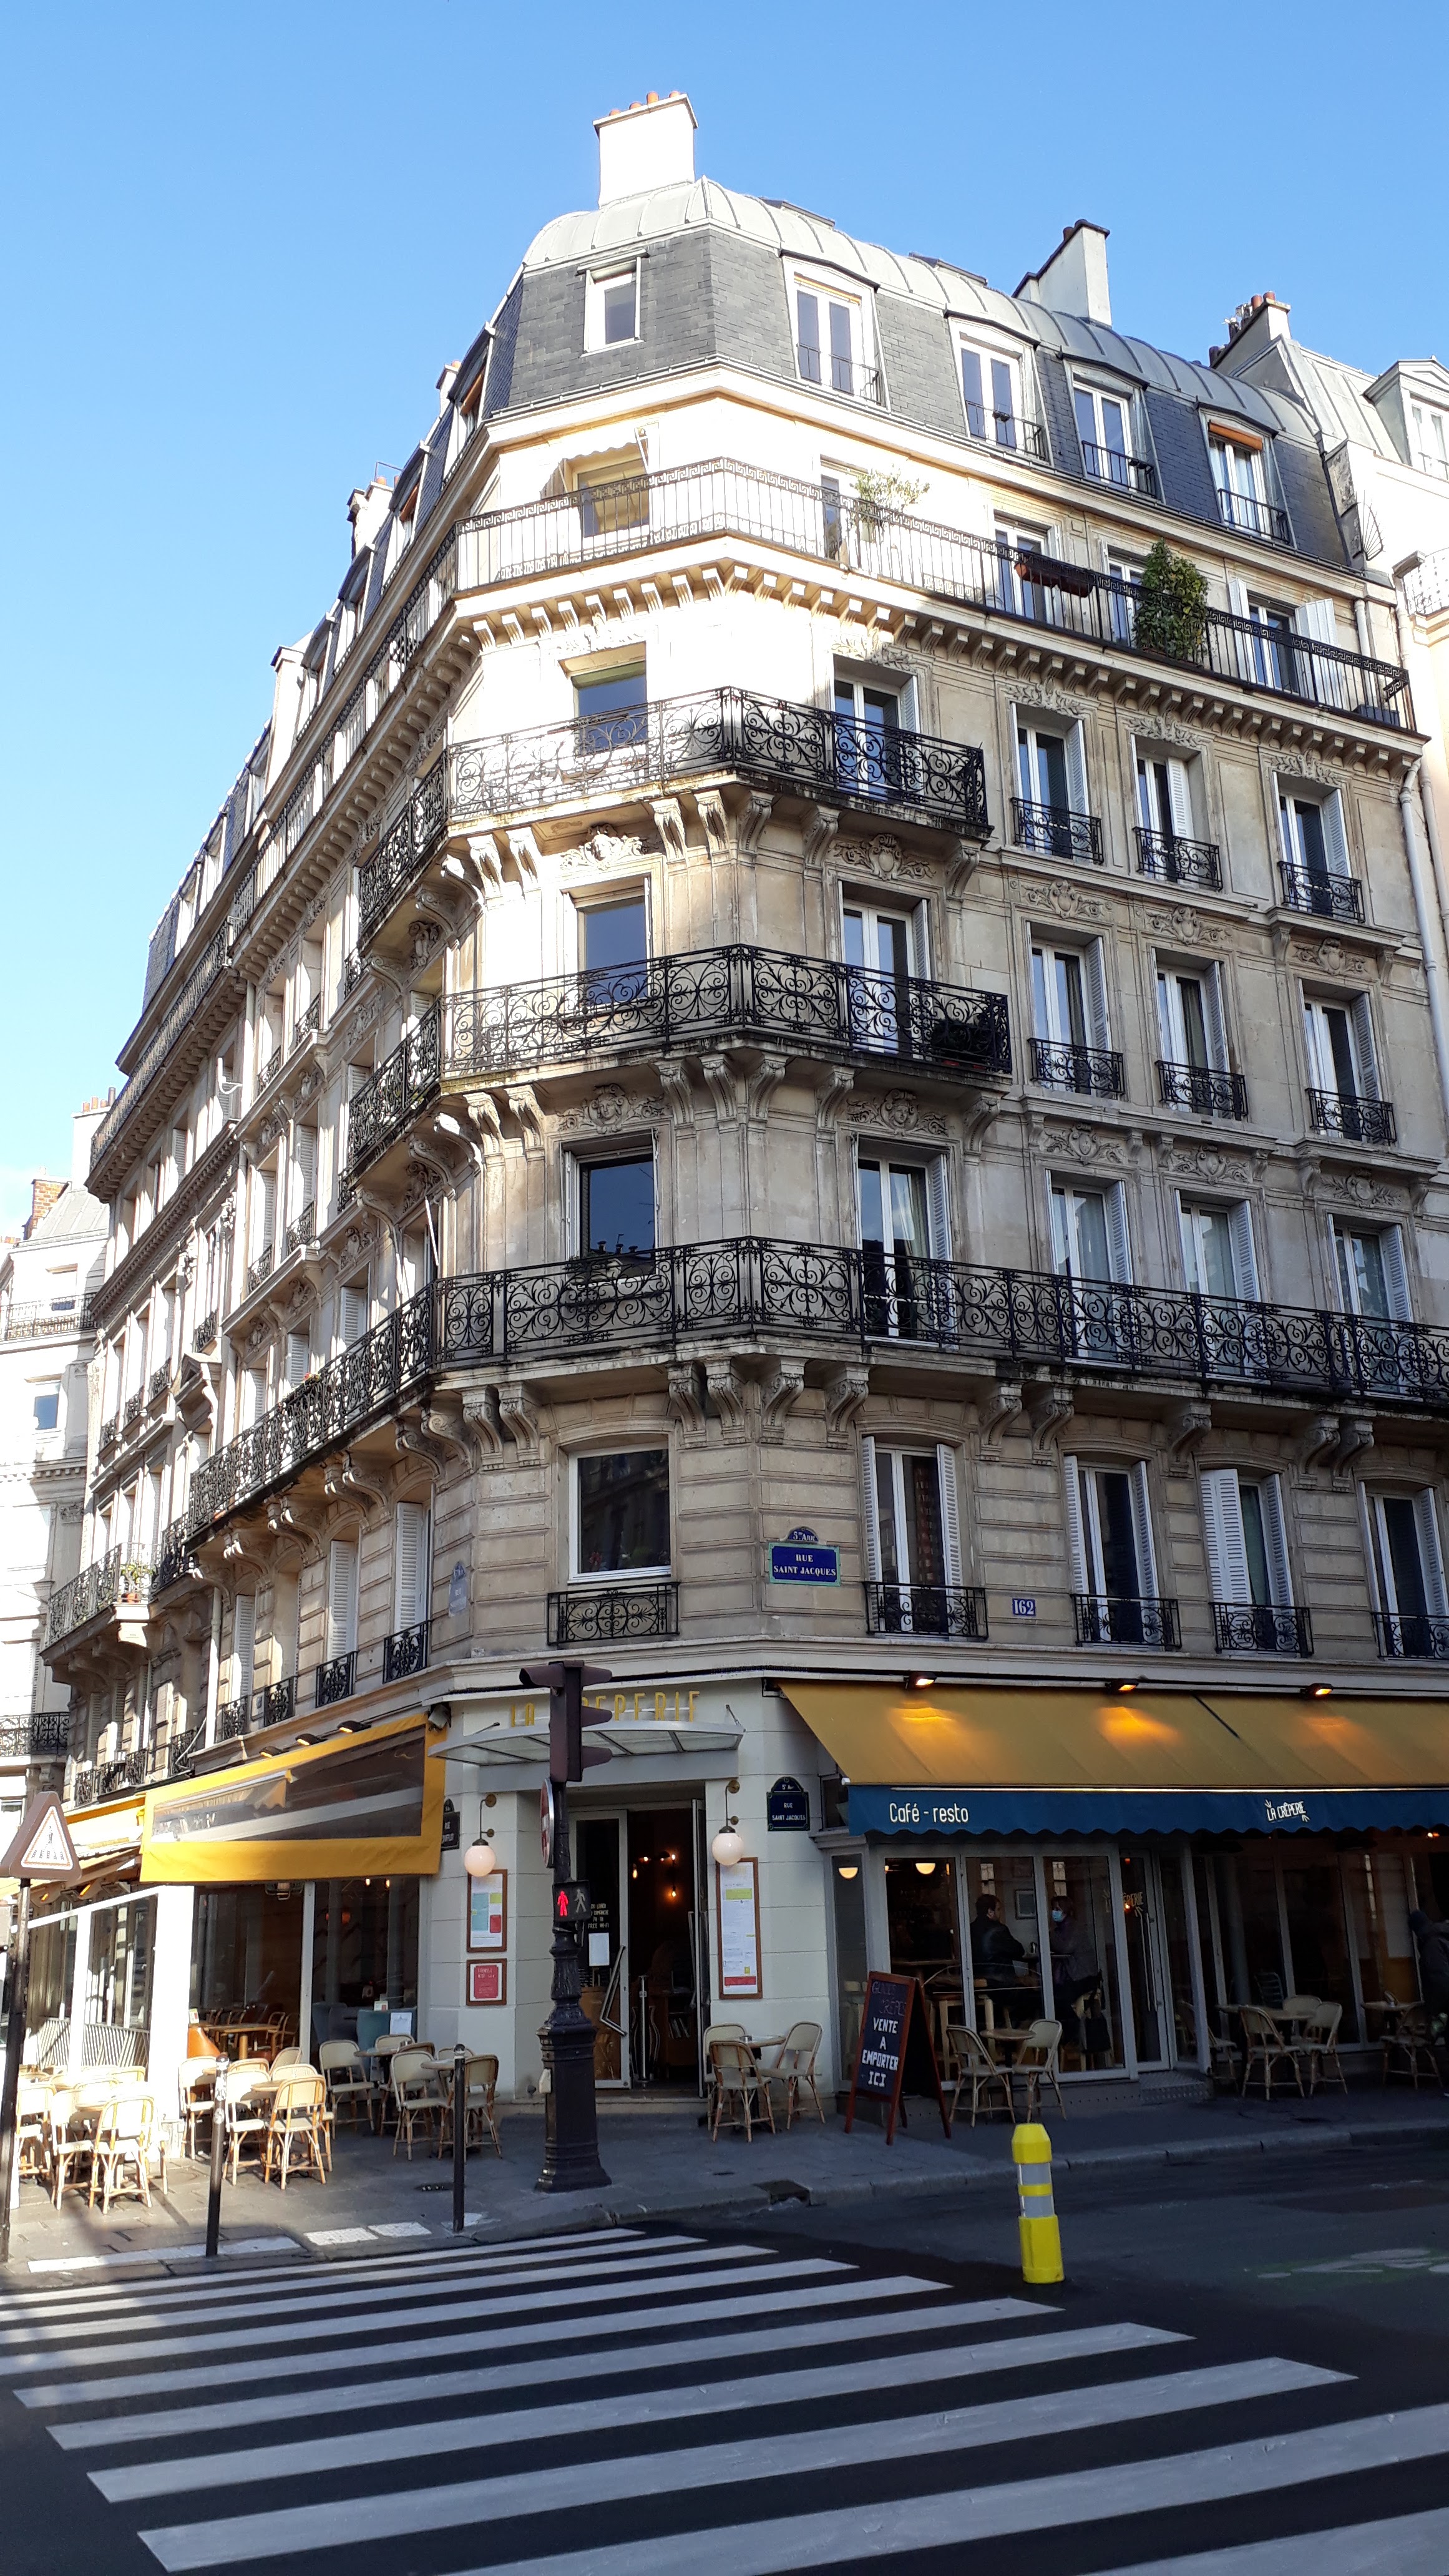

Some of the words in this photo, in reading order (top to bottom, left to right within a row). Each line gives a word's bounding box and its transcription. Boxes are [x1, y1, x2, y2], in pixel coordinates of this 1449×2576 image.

[796, 1554, 814, 1563] RUE
[774, 1565, 798, 1574] SAINT
[800, 1567, 836, 1576] JACQUES
[1013, 1599, 1034, 1615] 162
[510, 1702, 535, 1727] LA
[889, 1803, 920, 1823] Café
[932, 1803, 968, 1823] resto
[1267, 1807, 1277, 1822] LA
[874, 2017, 899, 2034] VENTE
[879, 2036, 887, 2051] A
[862, 2049, 899, 2071] EMPORTER
[867, 2071, 887, 2088] ICI
